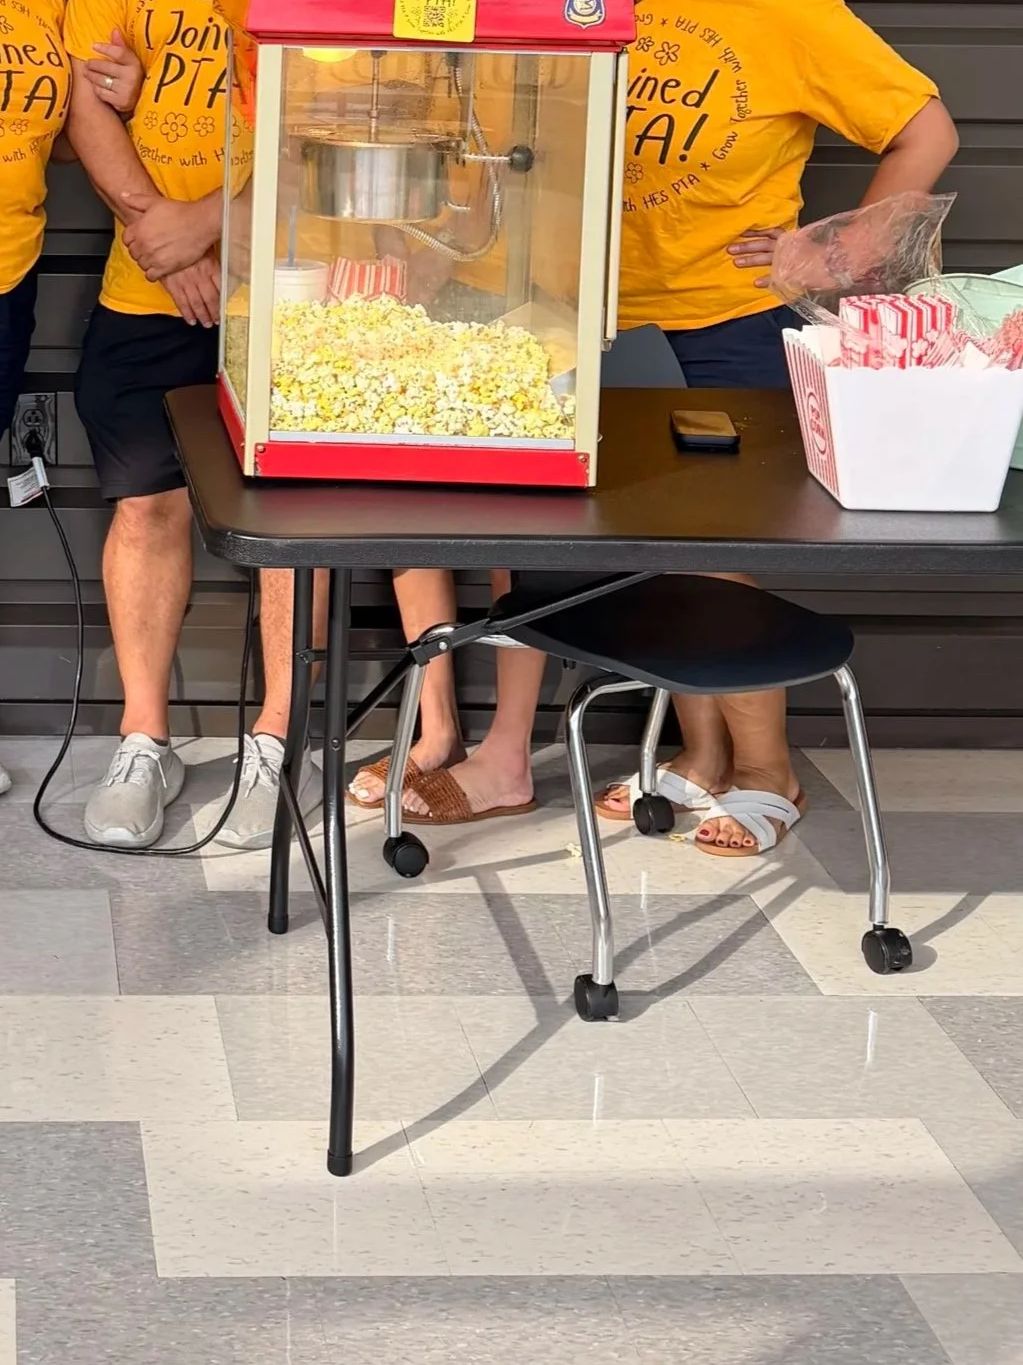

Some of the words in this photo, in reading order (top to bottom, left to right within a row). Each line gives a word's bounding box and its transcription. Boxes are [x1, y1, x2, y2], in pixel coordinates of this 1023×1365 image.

[145, 8, 155, 51] I
[674, 15, 700, 34] PTA
[698, 27, 724, 48] HES
[717, 46, 743, 74] with
[627, 67, 720, 109] ined
[729, 79, 753, 125] Together
[2, 150, 27, 164] with
[179, 150, 208, 167] with
[711, 130, 739, 161] Grow
[642, 189, 670, 210] HES
[670, 173, 701, 196] PTA
